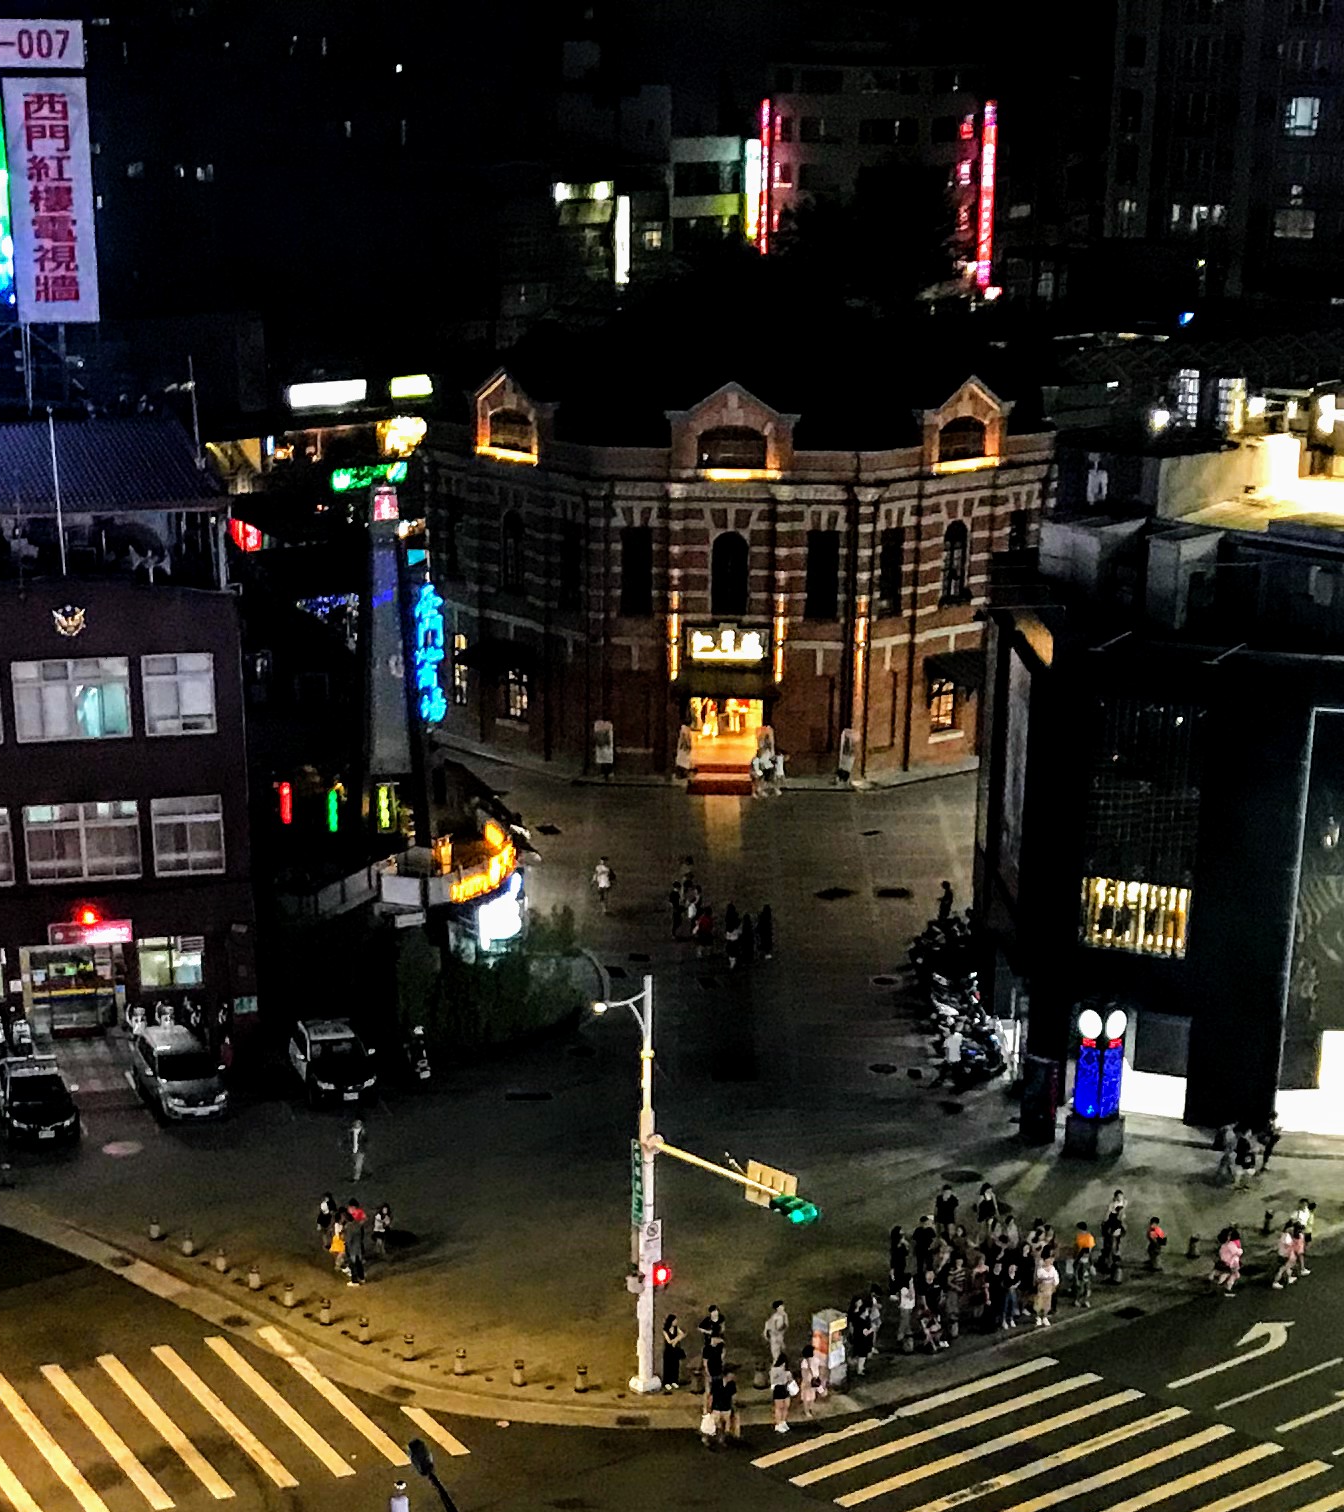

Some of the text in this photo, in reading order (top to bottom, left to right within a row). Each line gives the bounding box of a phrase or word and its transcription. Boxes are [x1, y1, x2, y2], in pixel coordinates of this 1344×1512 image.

[23, 92, 80, 304] 西門紅樓電視牆
